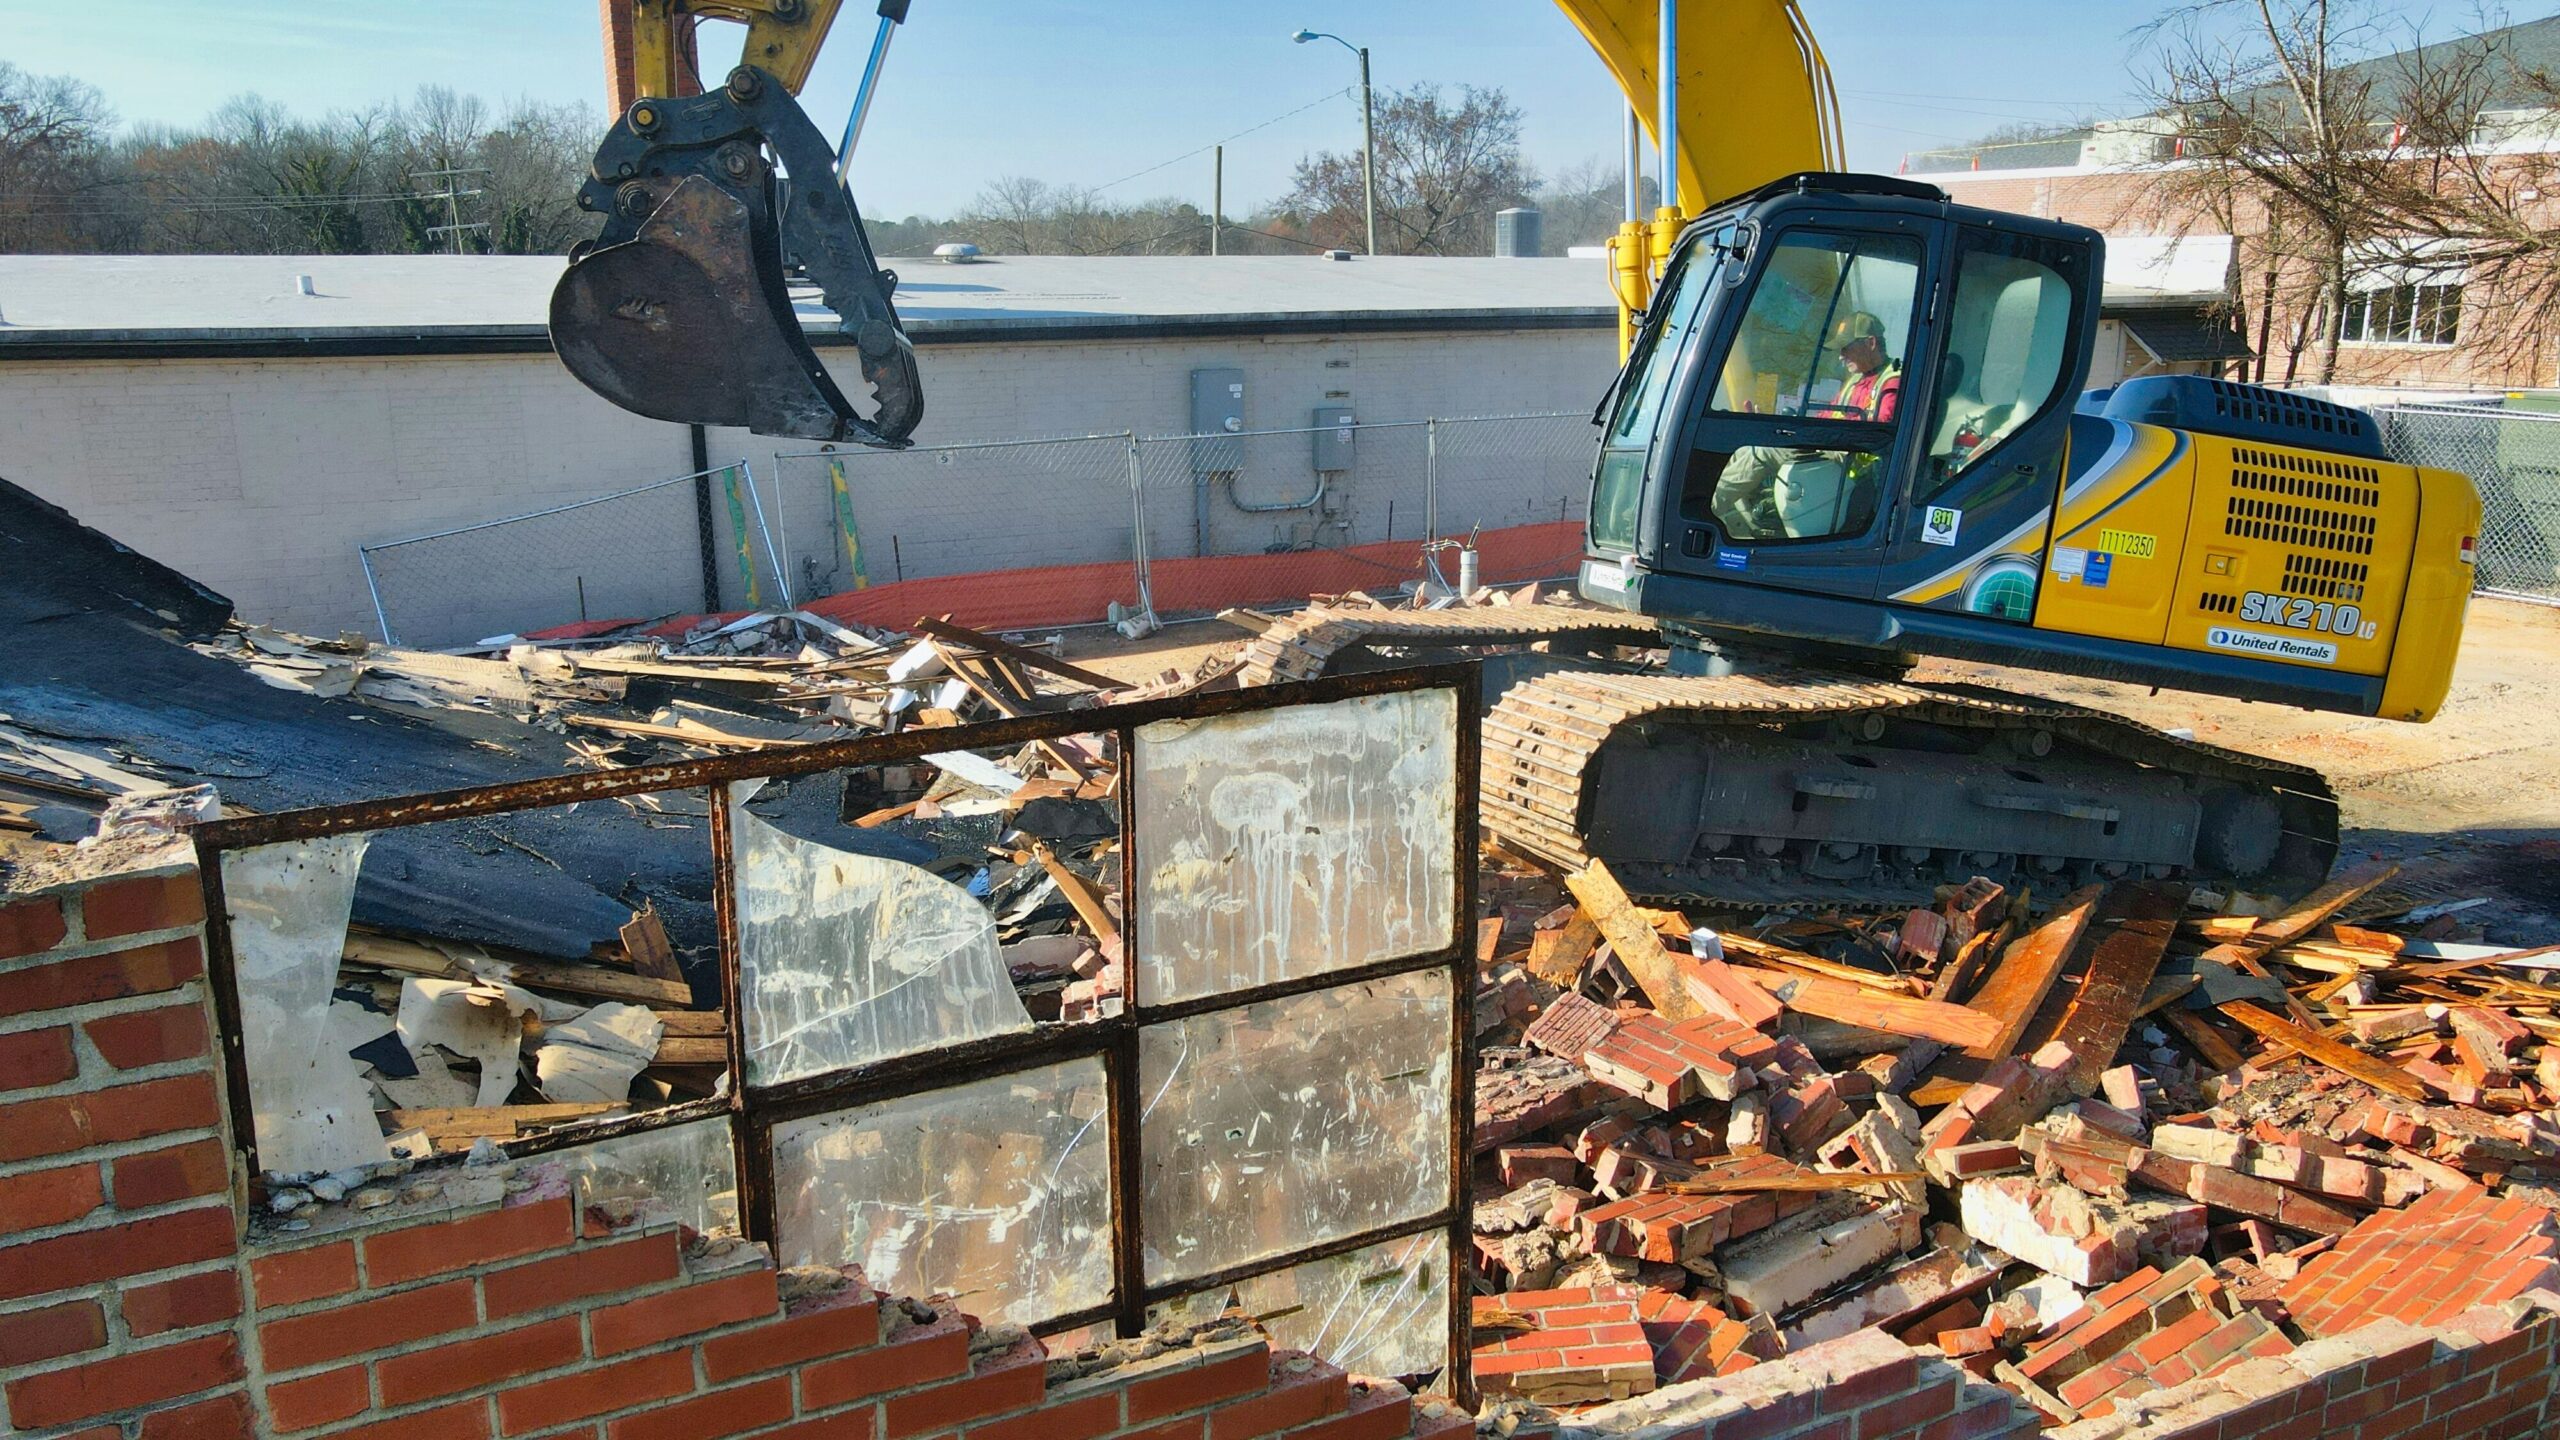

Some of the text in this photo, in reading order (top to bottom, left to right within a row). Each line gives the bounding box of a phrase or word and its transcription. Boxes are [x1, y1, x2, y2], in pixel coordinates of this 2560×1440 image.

[1932, 509, 1953, 526] 811
[2101, 531, 2153, 556] 11112350
[2240, 592, 2376, 639] SK210 LC
[2232, 634, 2329, 659] United Rentals
